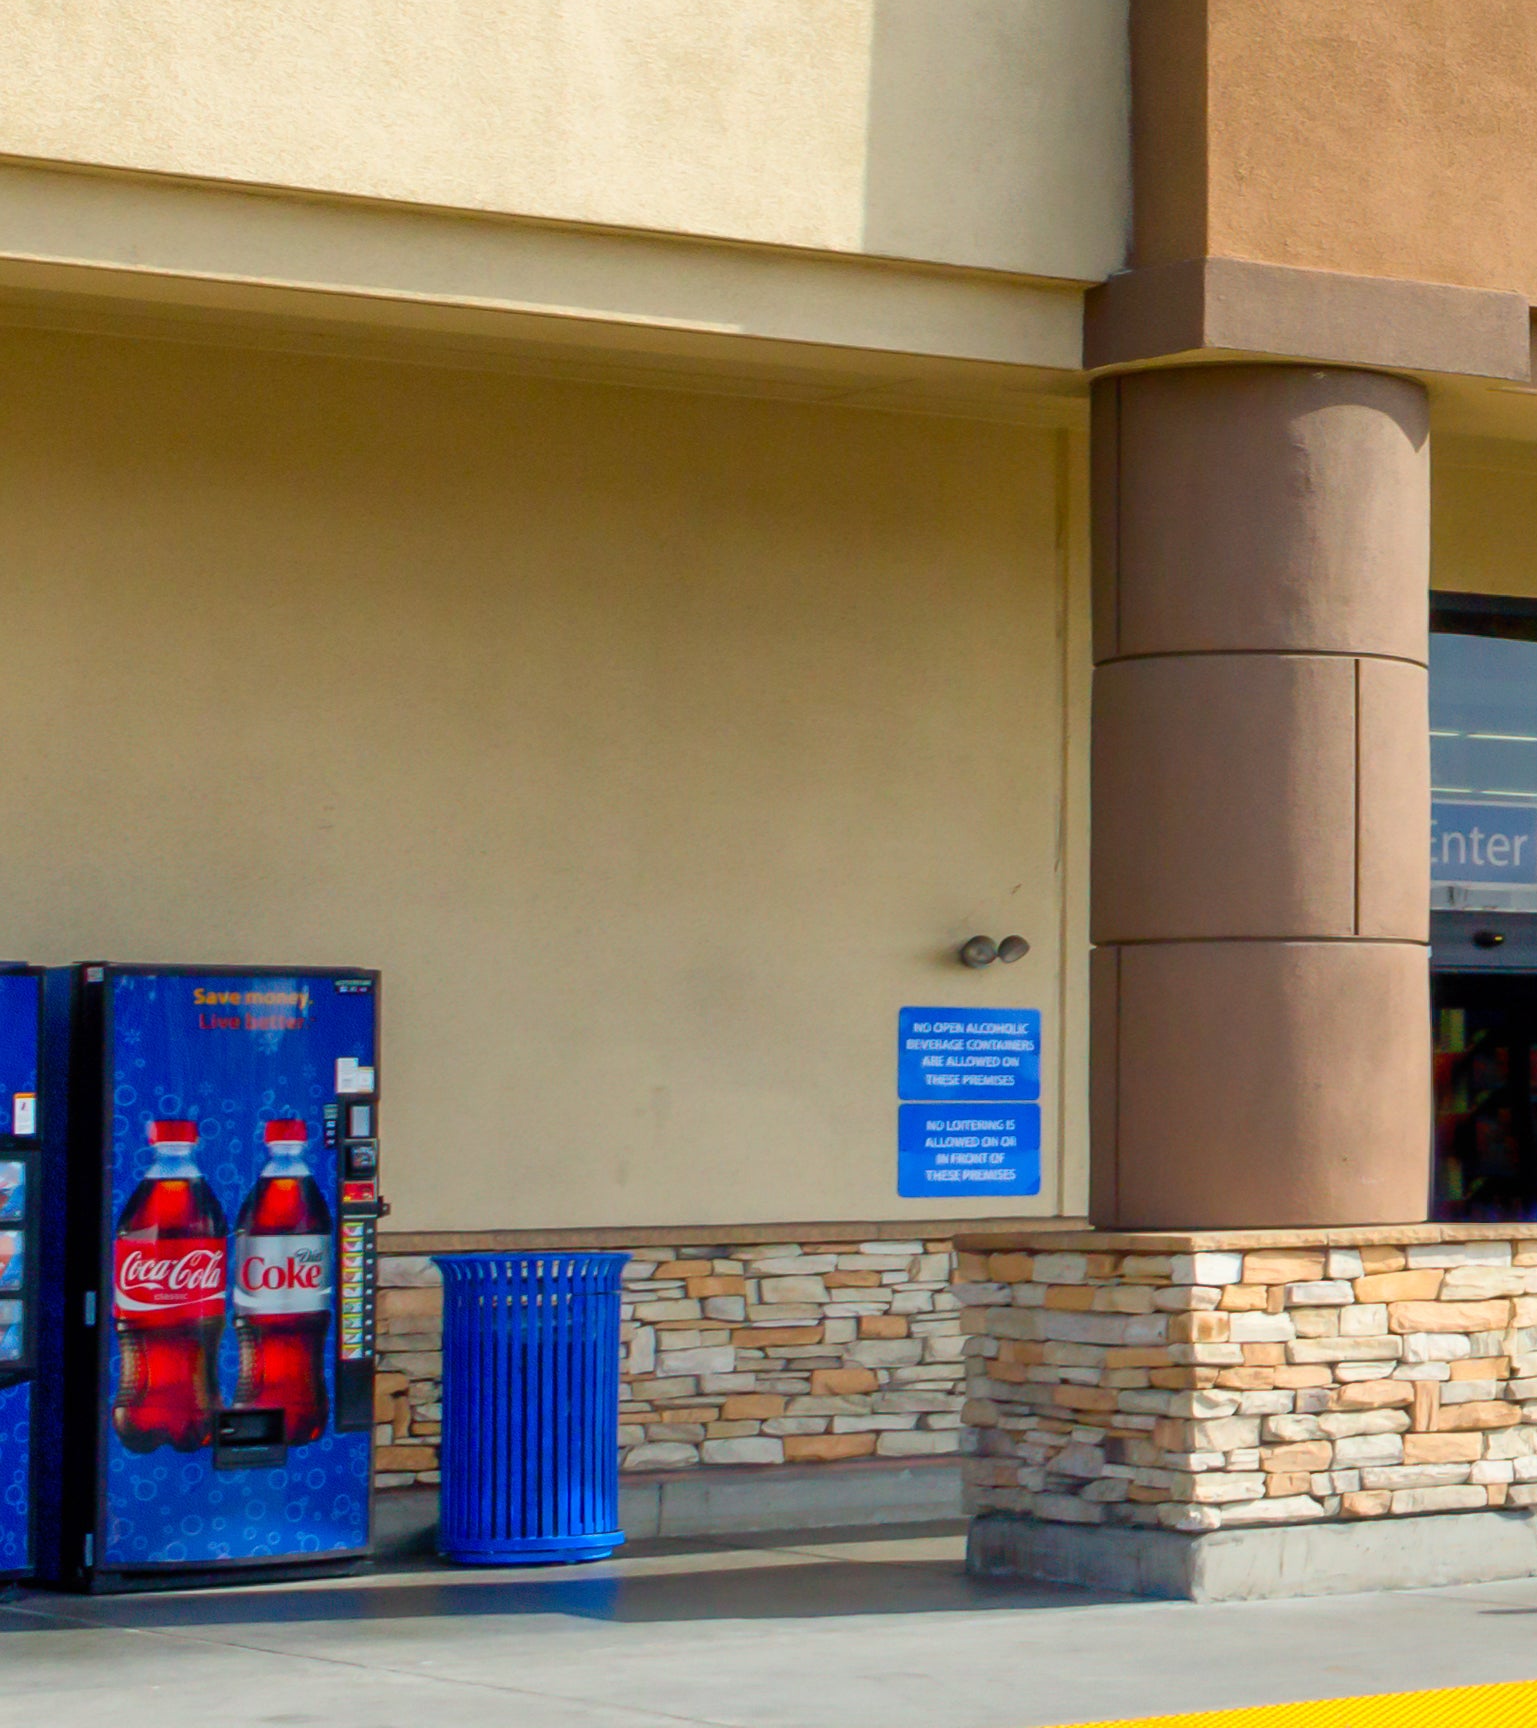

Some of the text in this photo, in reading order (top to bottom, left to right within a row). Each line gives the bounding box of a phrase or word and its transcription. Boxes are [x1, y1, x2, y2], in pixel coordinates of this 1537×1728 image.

[193, 988, 314, 1010] Save money.
[199, 1013, 241, 1030] Live
[913, 1022, 1029, 1035] NO OPEN ALCOHOLIC
[905, 1038, 1035, 1051] BEVERAGE CONTAINERS
[922, 1055, 1020, 1068] ARE ALLOWED ON
[925, 1074, 1015, 1086] THESE PREMISES
[926, 1119, 1016, 1131] NO LOITERING IS
[925, 1136, 1017, 1148] ALLOWED ON OR
[935, 1152, 1006, 1165] IN FRONT OF
[925, 1168, 1017, 1182] THESE PREMISES
[120, 1249, 223, 1290] Coca-Cola
[241, 1256, 321, 1291] Coke
